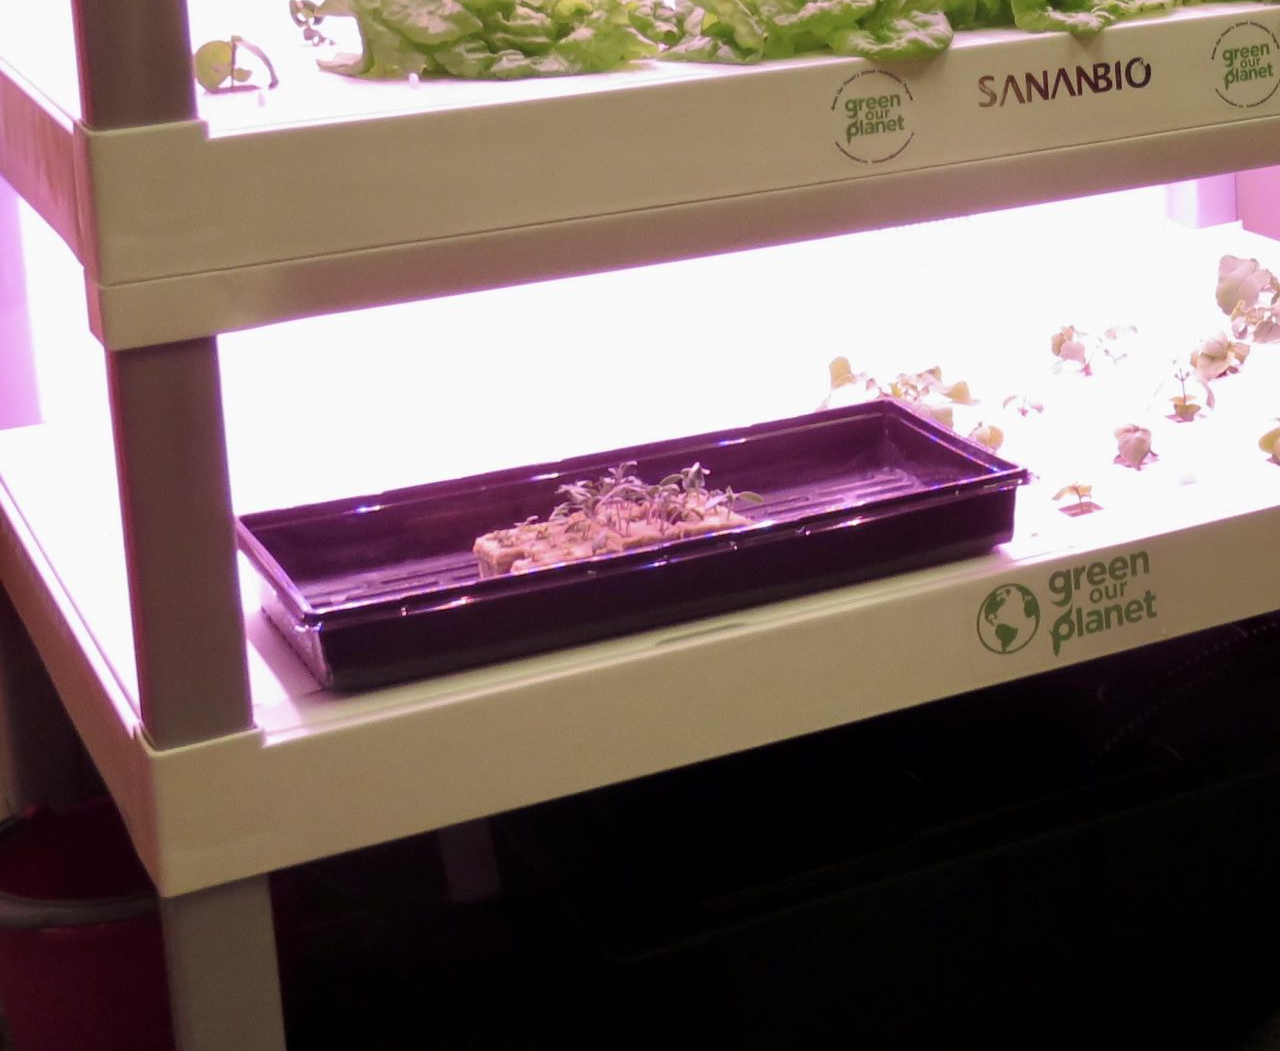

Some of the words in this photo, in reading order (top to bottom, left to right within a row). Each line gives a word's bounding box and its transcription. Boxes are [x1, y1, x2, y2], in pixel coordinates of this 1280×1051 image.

[1221, 43, 1270, 68] green
[1240, 57, 1261, 69] our
[978, 56, 1152, 109] SANANBIO
[1224, 62, 1274, 91] planet
[844, 93, 902, 119] green
[865, 109, 890, 121] our
[846, 114, 905, 145] planet
[1049, 550, 1150, 607] green
[1089, 580, 1128, 604] our
[1049, 590, 1158, 657] planet
